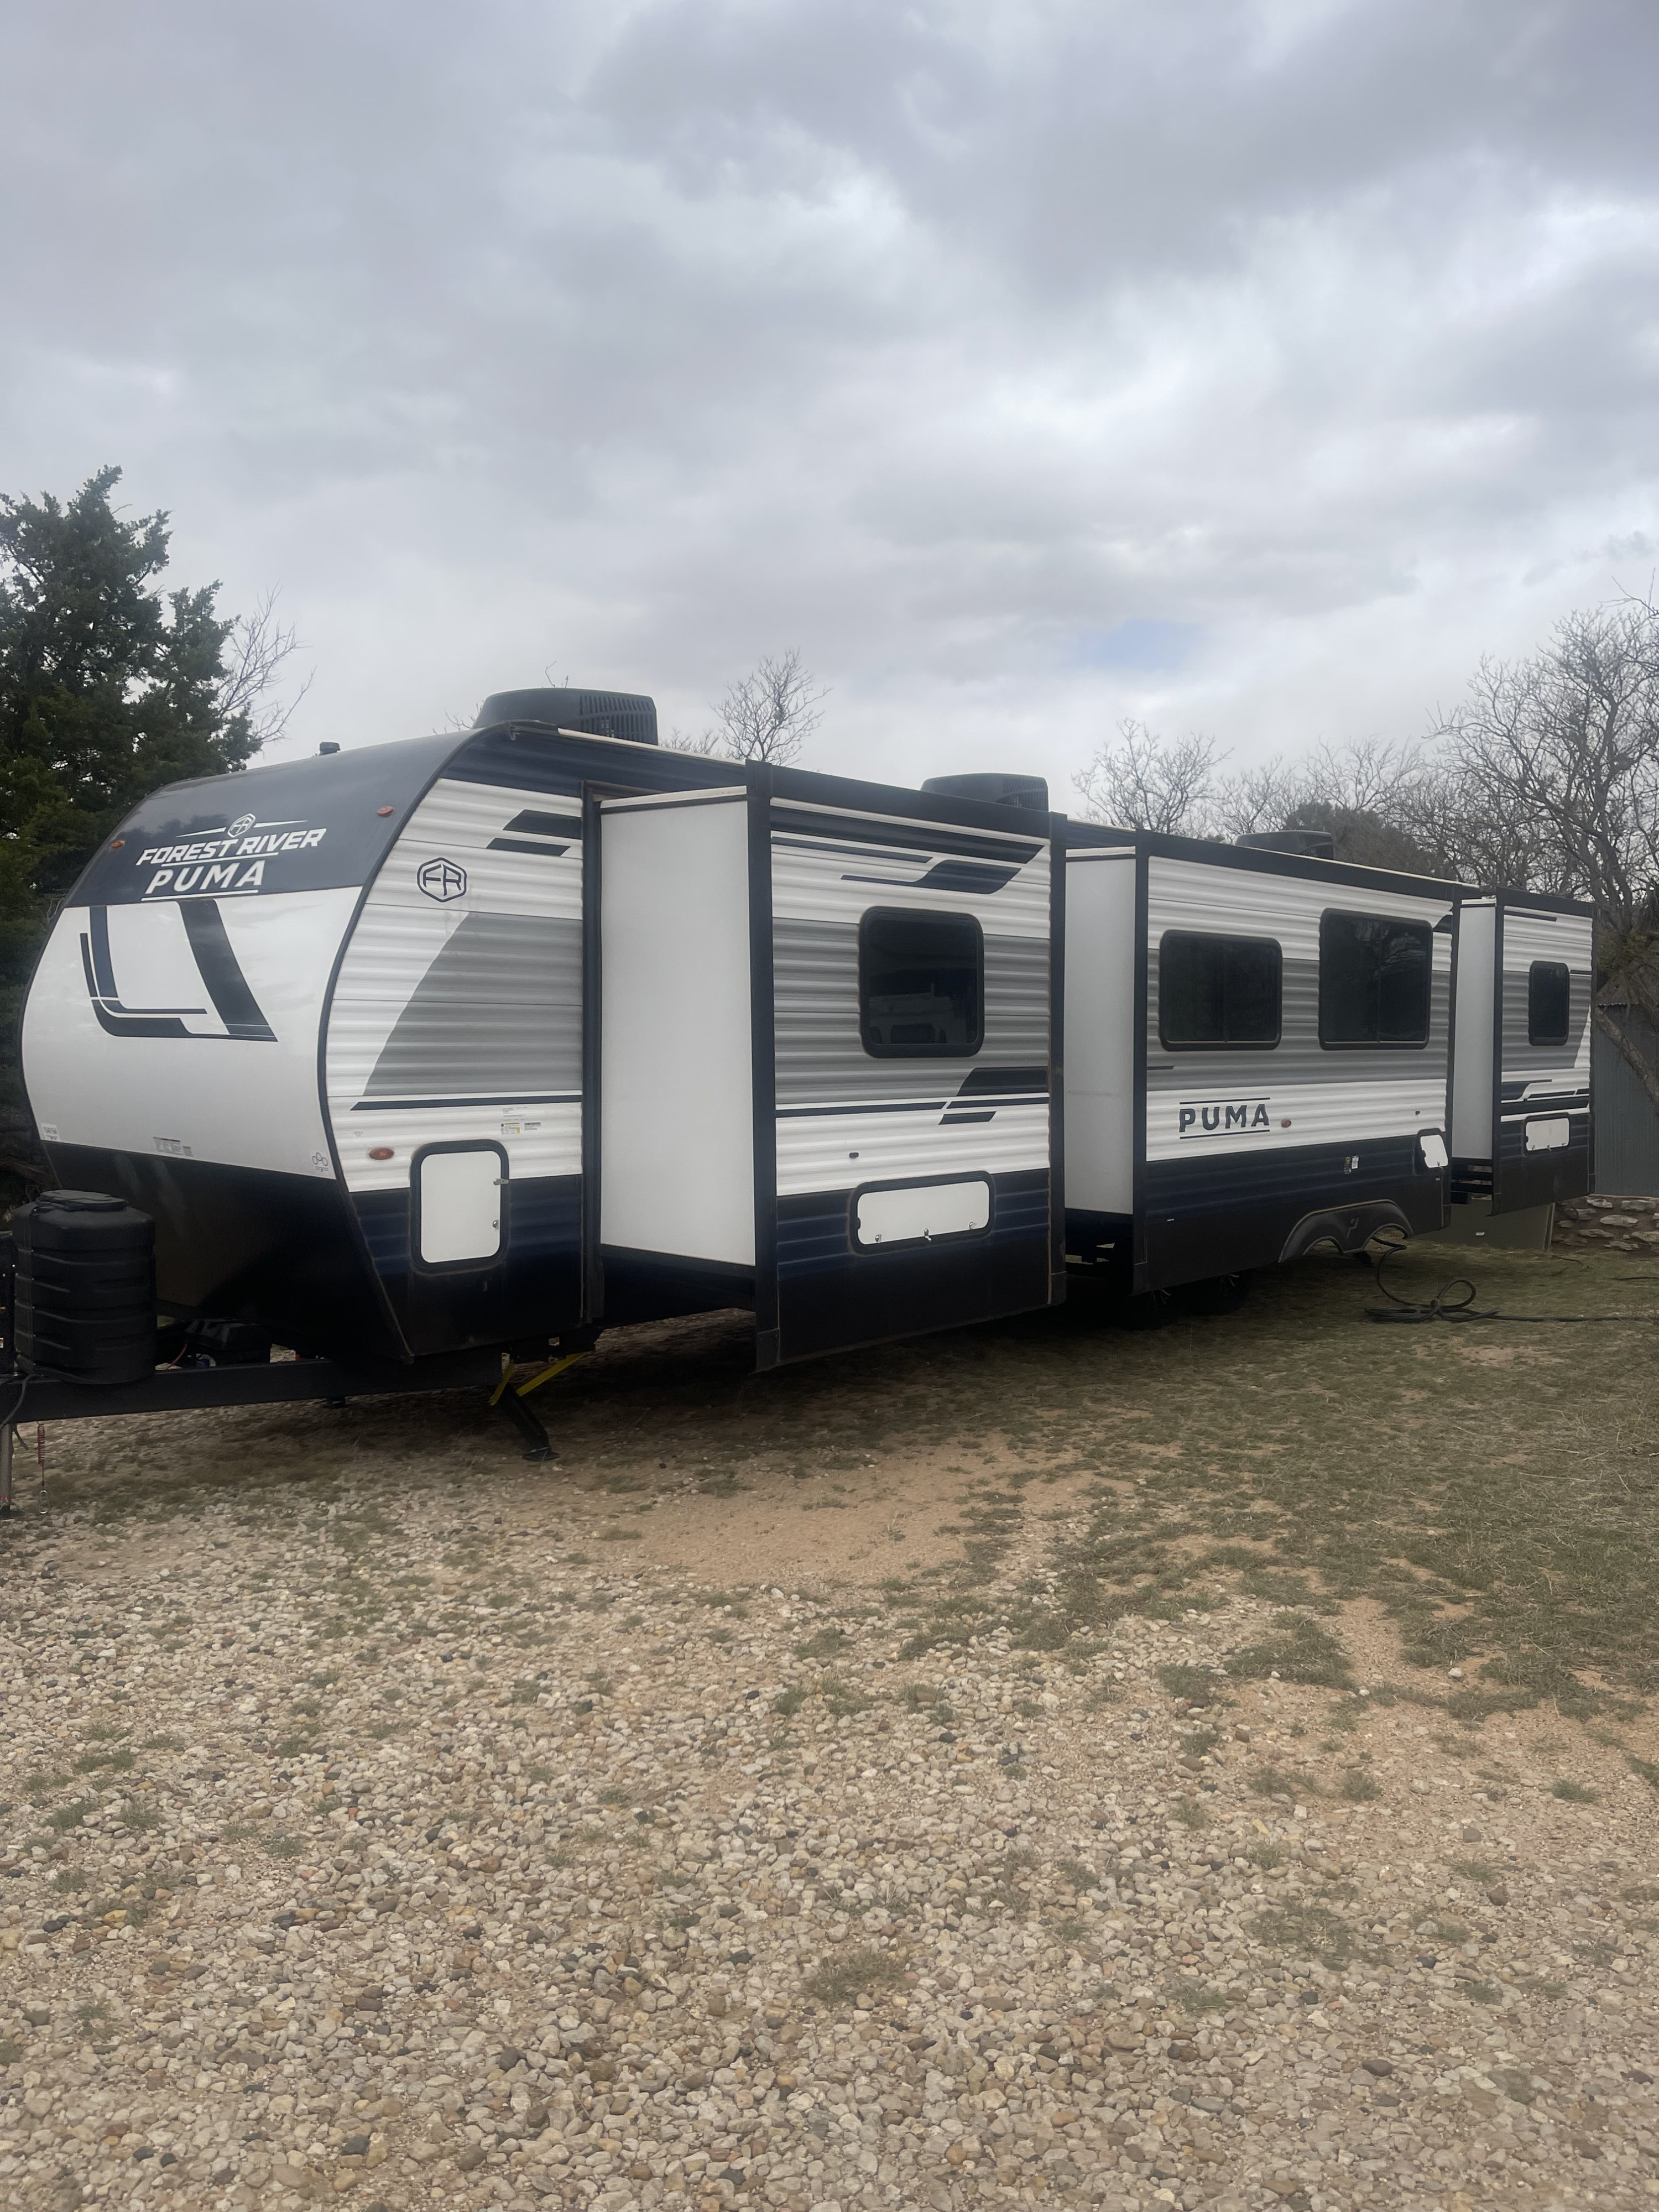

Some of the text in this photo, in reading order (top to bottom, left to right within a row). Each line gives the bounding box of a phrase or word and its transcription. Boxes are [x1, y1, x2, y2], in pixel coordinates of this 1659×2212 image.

[135, 828, 327, 866] FOREST RIVER
[144, 860, 265, 895] PUMA
[1179, 1104, 1270, 1133] PUMA
